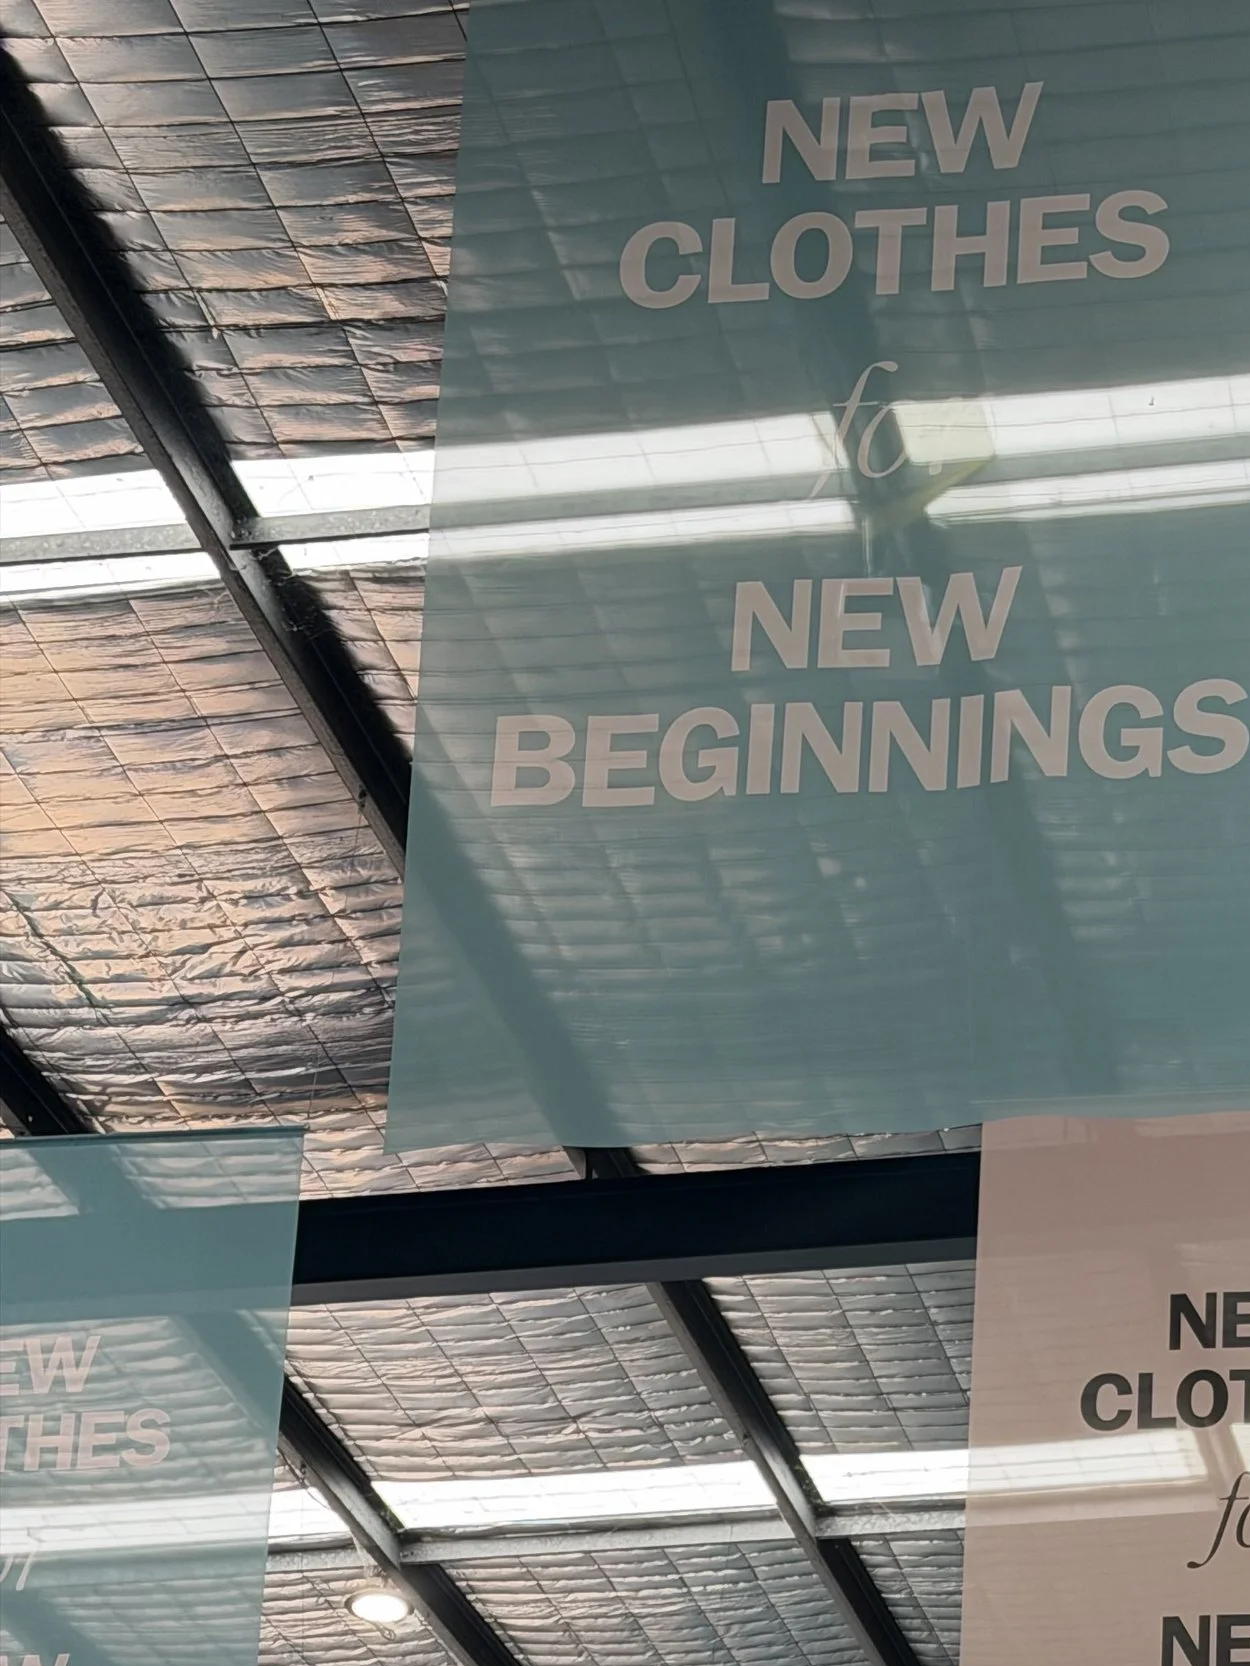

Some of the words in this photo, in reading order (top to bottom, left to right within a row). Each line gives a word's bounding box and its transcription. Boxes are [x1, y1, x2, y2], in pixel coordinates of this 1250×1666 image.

[762, 81, 1043, 184] NEW
[619, 190, 1169, 309] CLOTHES
[731, 566, 1022, 672] NEW
[491, 679, 1250, 807] BEGINNINGS
